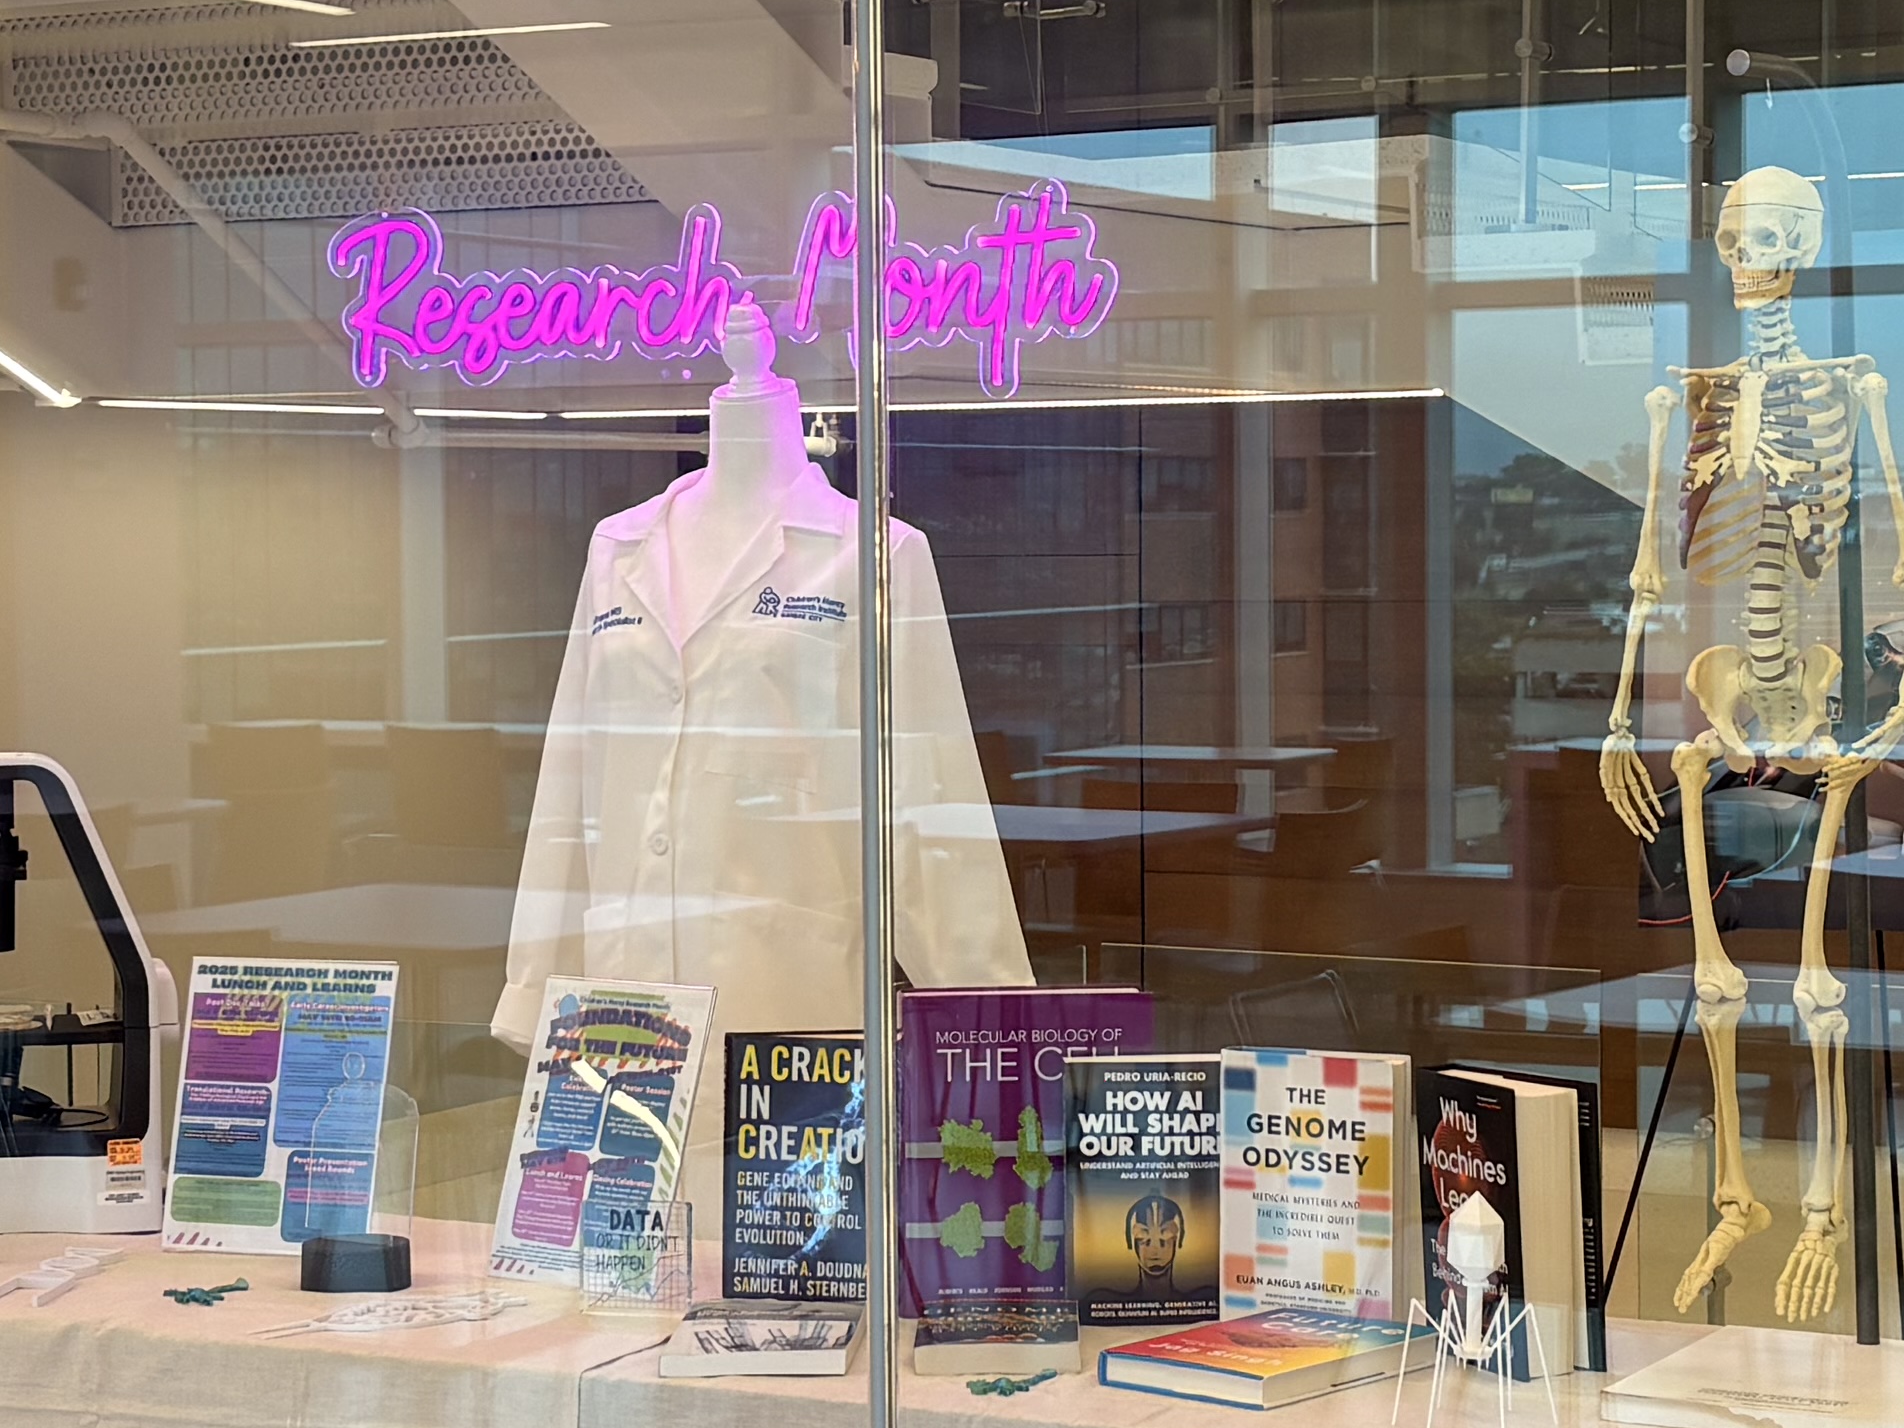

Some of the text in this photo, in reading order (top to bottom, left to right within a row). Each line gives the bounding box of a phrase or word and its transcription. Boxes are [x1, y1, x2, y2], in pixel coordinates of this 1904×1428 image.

[338, 193, 1102, 386] Research Month
[198, 964, 392, 981] 2025 RESEARCH MONTH
[212, 978, 376, 994] LUNCH AND LEARNS
[936, 1028, 1122, 1044] MOLECULAR BIOLOGY OF
[740, 1044, 865, 1084] A CRACK
[937, 1048, 1018, 1082] THE
[1104, 1072, 1206, 1082] PEDRO URIA-RECIO
[739, 1084, 770, 1120] IN
[1105, 1091, 1203, 1111] HOW AI
[1286, 1088, 1326, 1105] THE
[1078, 1114, 1138, 1134] WILL
[1246, 1113, 1367, 1142] GENOME
[1440, 1097, 1477, 1143] Why
[738, 1124, 865, 1164] CREATIO
[1079, 1136, 1135, 1157] OUR
[1242, 1147, 1370, 1176] ODYSSEY
[1423, 1136, 1506, 1185] Machines
[738, 1172, 770, 1186] GENE
[737, 1190, 760, 1205] THE
[1253, 1192, 1360, 1209] MEDICAL MYSTERIES AND
[1440, 1177, 1471, 1209] Lea
[610, 1209, 664, 1232] DATA
[736, 1209, 780, 1225] POWER
[785, 1211, 800, 1226] TO
[1258, 1208, 1272, 1218] THE
[1328, 1216, 1355, 1225] QUEST
[596, 1234, 613, 1248] OR
[618, 1234, 630, 1250] IT
[736, 1228, 804, 1245] EVOLUTION
[1273, 1226, 1340, 1240] TO SOLVE THEM
[596, 1255, 646, 1270] HAPPEN
[734, 1258, 795, 1276] JENNIFER
[800, 1261, 812, 1276] A.
[734, 1277, 866, 1298] SAMUEL H. STERNBE
[1236, 1275, 1346, 1295] EUAN ANGUS ASHLEY,
[1261, 1321, 1361, 1340] Care
[1267, 1312, 1405, 1336] Future
[1207, 1347, 1283, 1366] Singh
